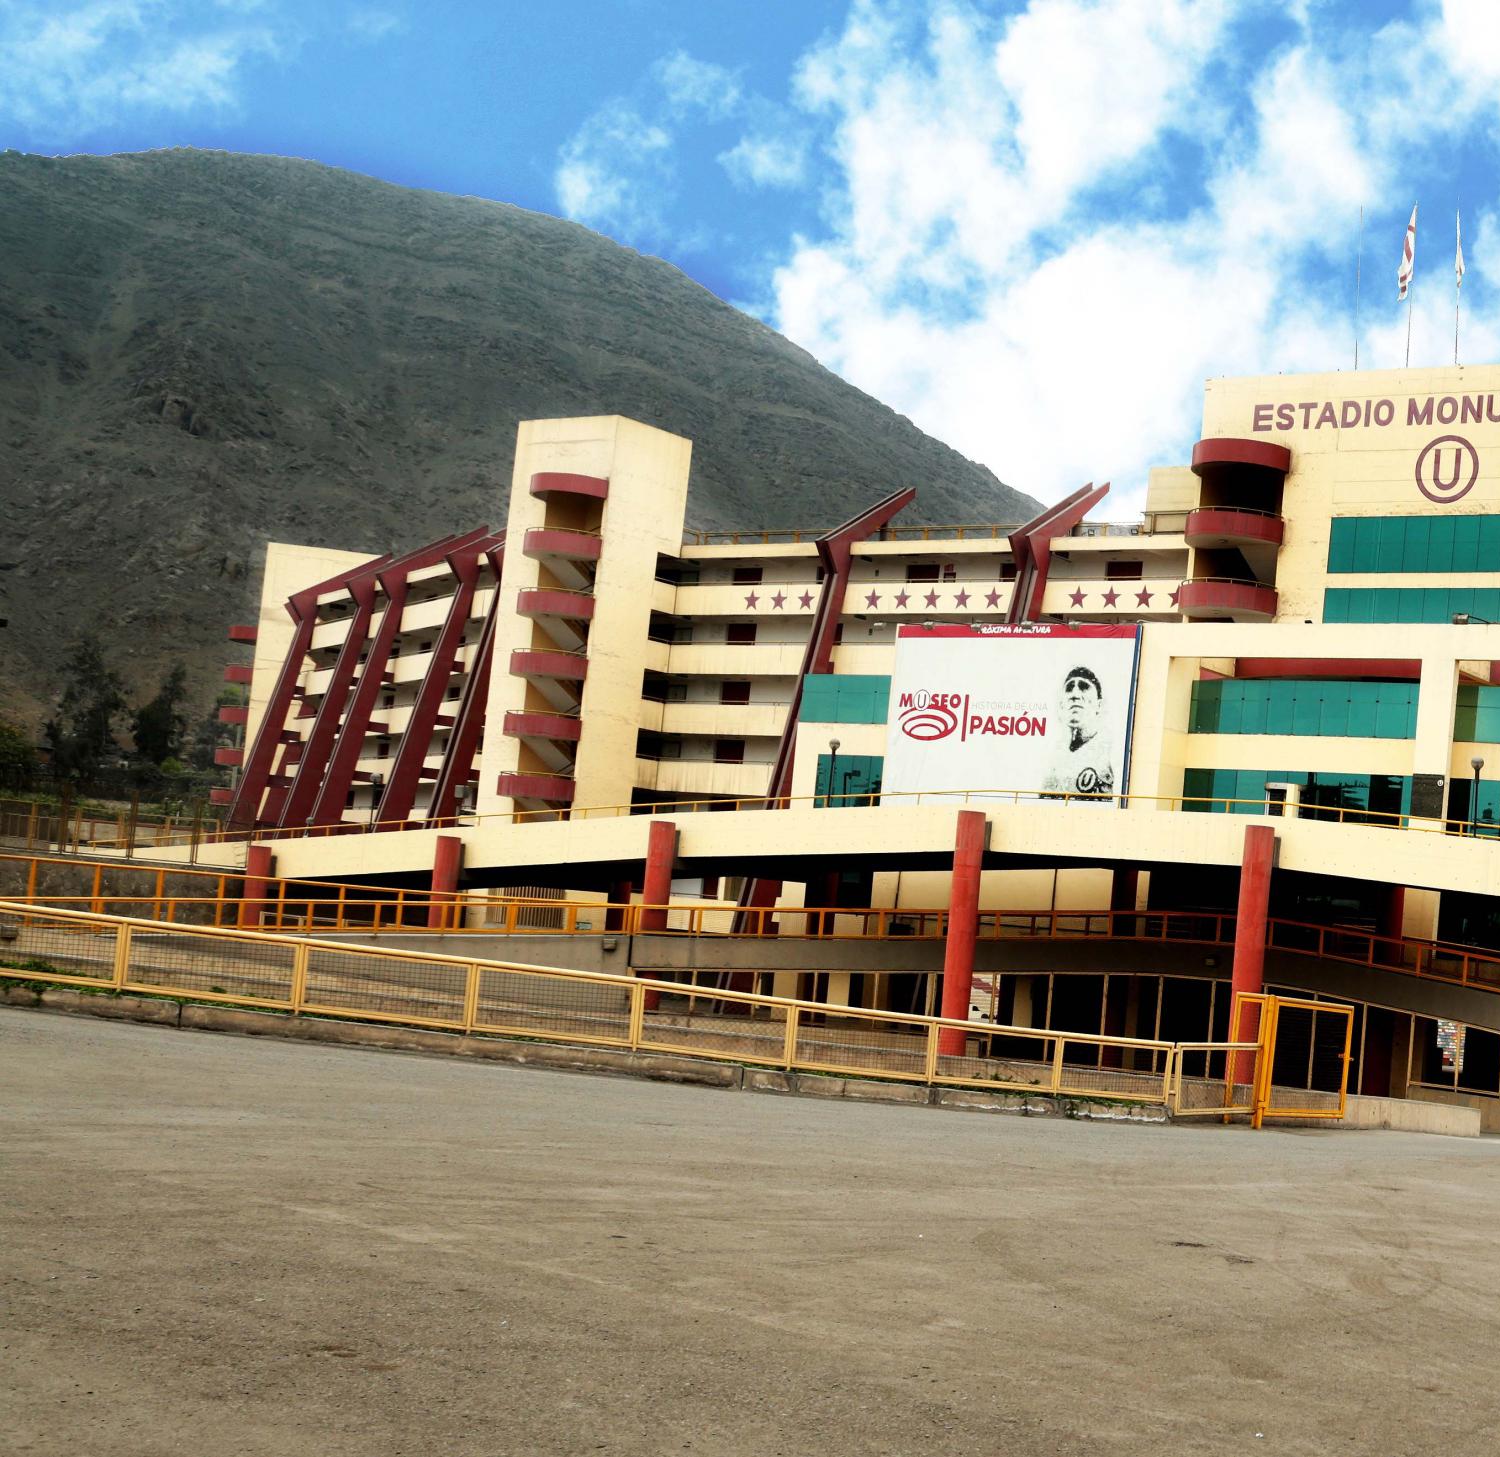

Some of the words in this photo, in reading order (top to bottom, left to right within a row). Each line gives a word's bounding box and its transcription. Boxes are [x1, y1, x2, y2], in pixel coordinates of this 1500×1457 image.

[1252, 399, 1395, 432] ESTADIO
[1433, 448, 1462, 491] U
[977, 624, 1012, 634] RÓXIMA
[899, 692, 962, 708] MUSEO
[971, 701, 1012, 711] HISTORIA
[1015, 702, 1026, 711] DE
[1028, 703, 1048, 711] UNA
[969, 711, 1047, 737] PASIÓN
